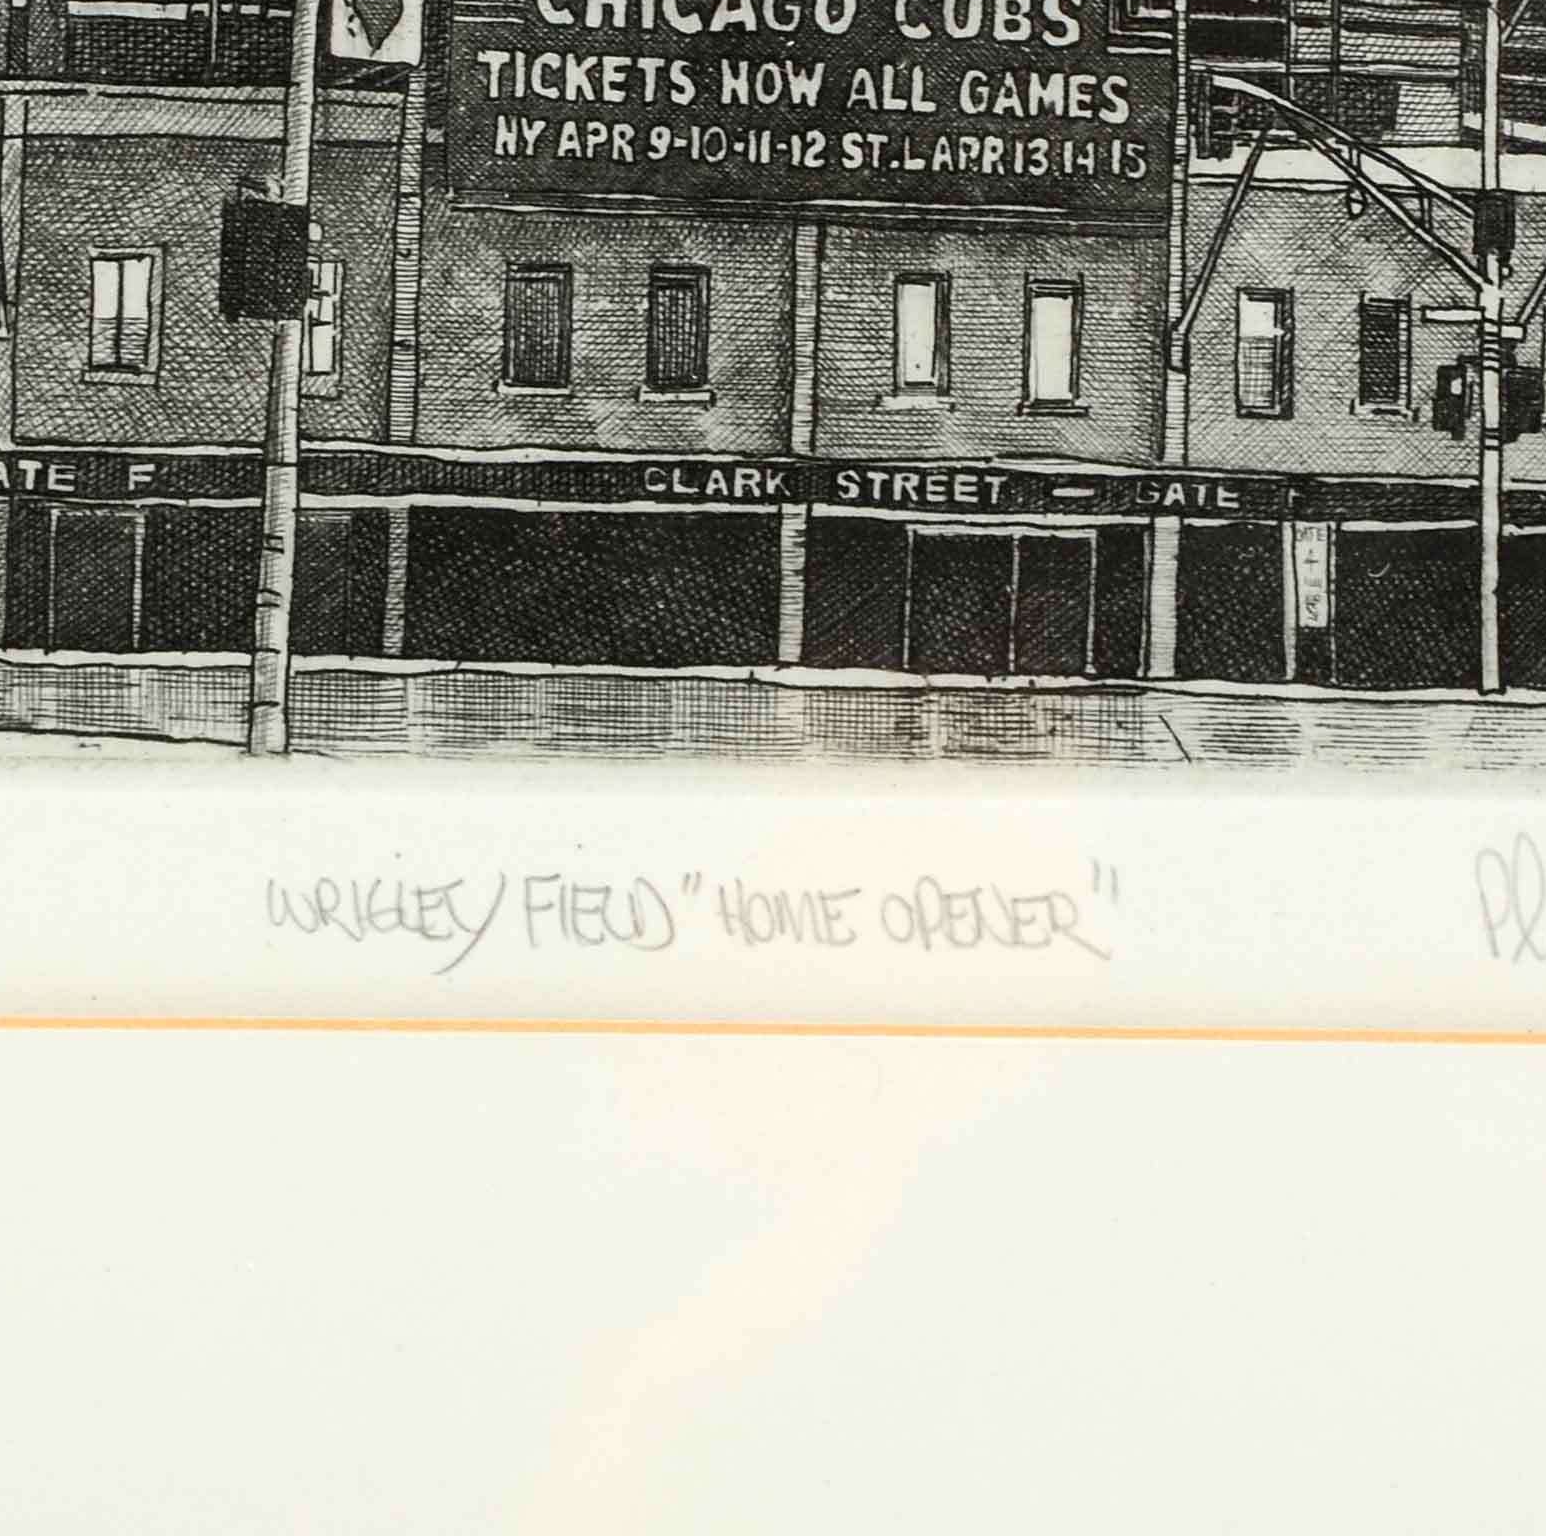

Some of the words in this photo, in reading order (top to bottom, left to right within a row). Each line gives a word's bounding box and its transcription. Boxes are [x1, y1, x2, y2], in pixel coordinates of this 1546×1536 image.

[477, 49, 697, 107] TICKETS
[719, 58, 827, 110] NOW
[848, 64, 938, 114] ALL
[959, 70, 1130, 125] GAMES
[494, 115, 546, 157] NY
[557, 120, 635, 163] APR
[128, 464, 155, 491] F
[643, 465, 791, 498] CLARK
[836, 469, 1009, 505] STREET
[1134, 481, 1241, 509] GATE
[523, 872, 676, 951] FIELD
